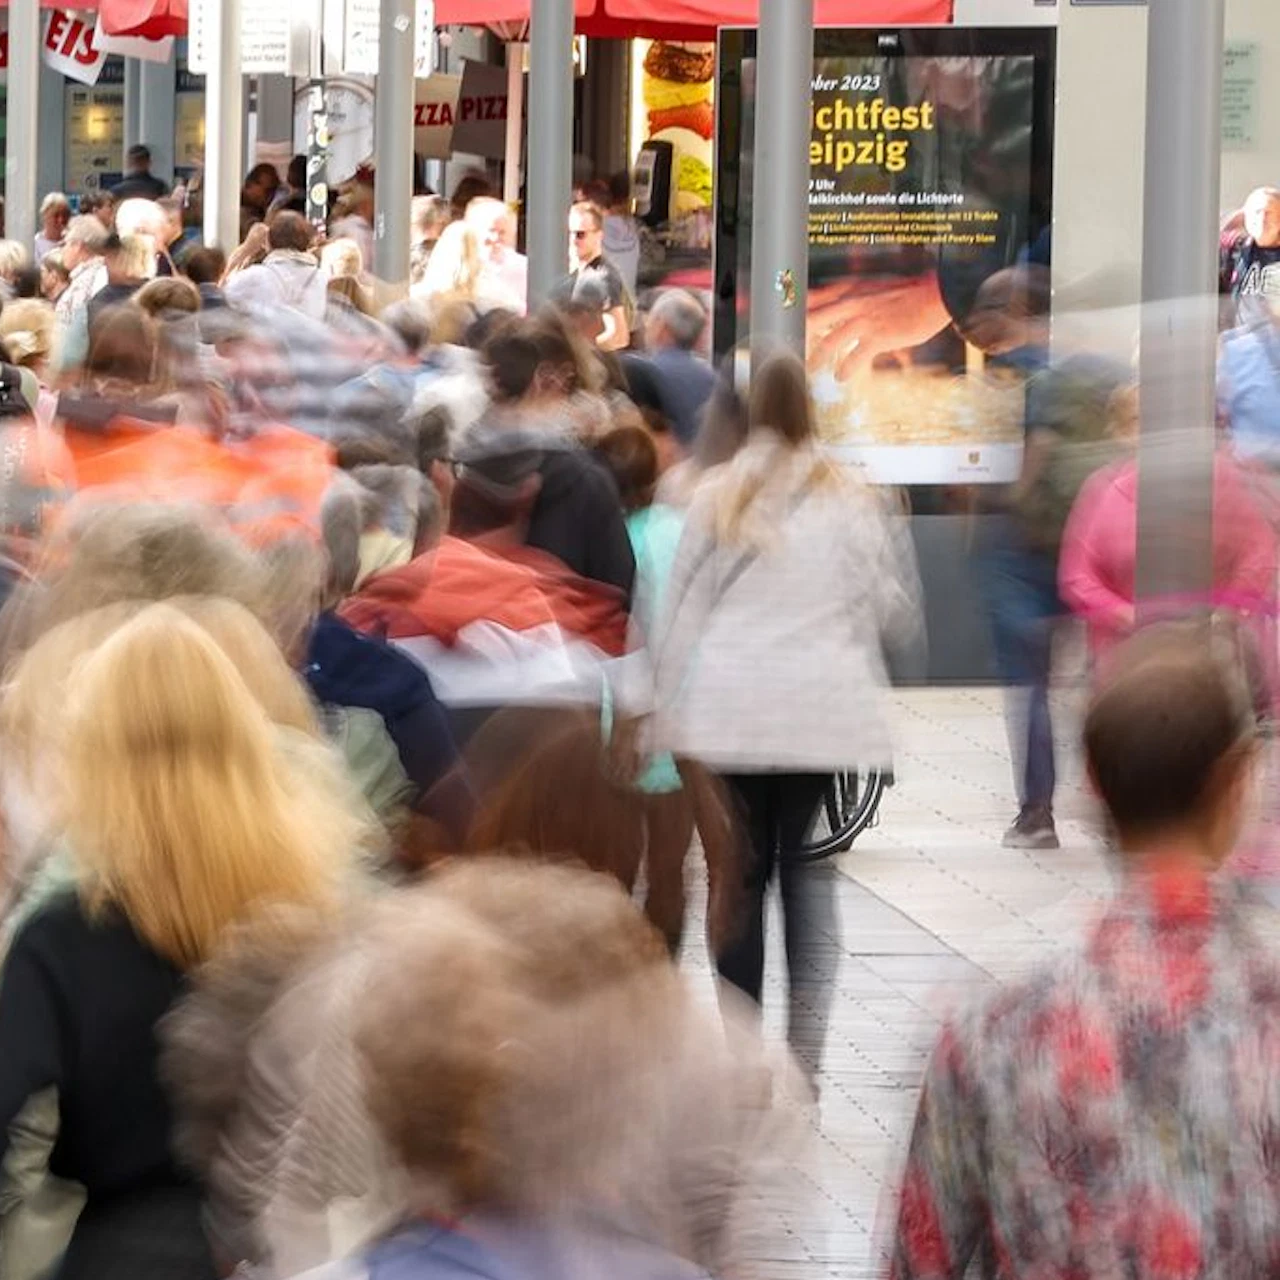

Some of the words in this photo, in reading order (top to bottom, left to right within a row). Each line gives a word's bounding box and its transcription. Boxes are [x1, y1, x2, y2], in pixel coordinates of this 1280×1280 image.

[46, 9, 101, 65] EIS
[810, 74, 838, 91] ber
[840, 75, 881, 91] 2023
[414, 102, 454, 127] ZZA
[461, 95, 508, 122] PIZZ
[814, 98, 934, 131] chtfest
[809, 132, 908, 173] eipzig
[816, 180, 837, 190] Uhr
[866, 193, 896, 206] sowie
[898, 192, 915, 205] die
[917, 192, 964, 205] Lichtorte
